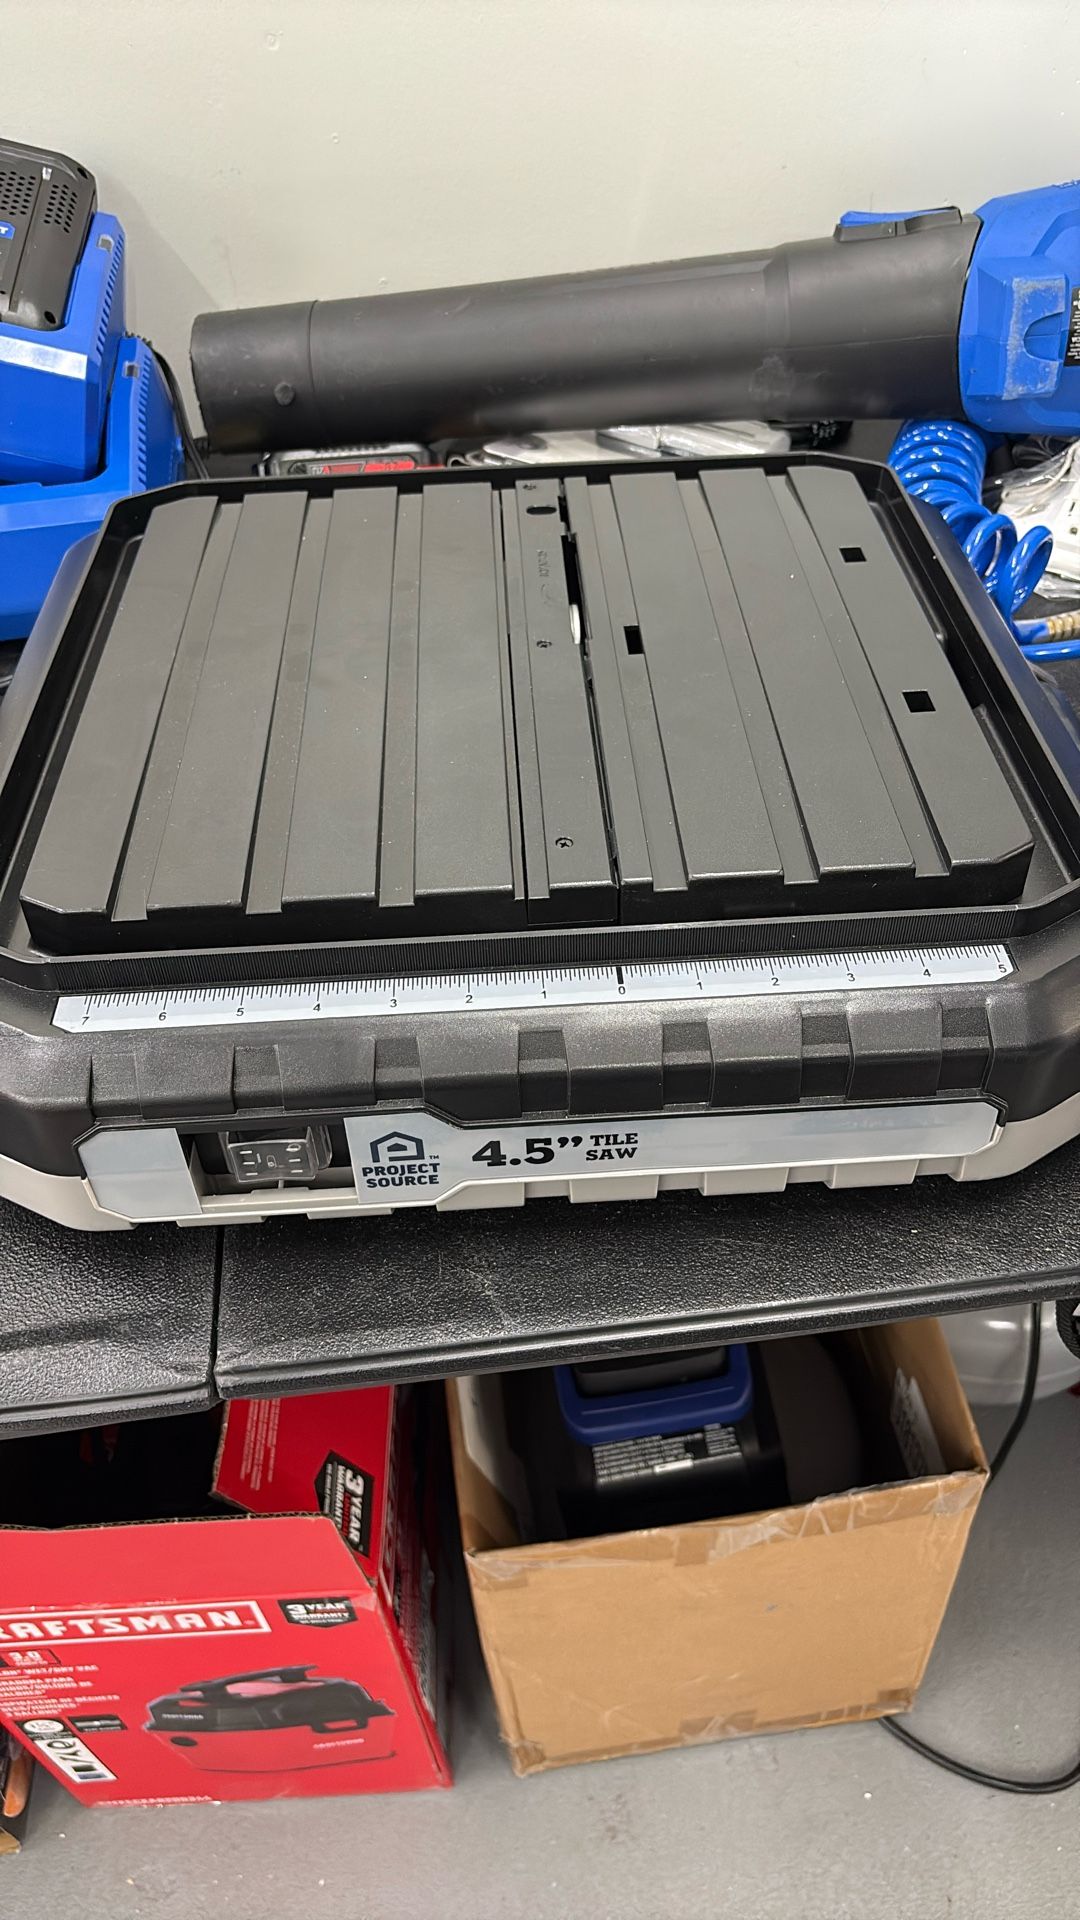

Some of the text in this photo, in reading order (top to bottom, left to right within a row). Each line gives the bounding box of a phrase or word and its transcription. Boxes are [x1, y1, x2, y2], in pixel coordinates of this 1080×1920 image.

[80, 964, 1007, 1026] 7 6 5 4 3 2 1 0 1 2 3 4 5
[589, 1132, 639, 1147] TILE
[585, 1147, 638, 1161] SAW
[361, 1162, 441, 1177] PROJECT
[366, 1174, 440, 1189] SOURCE
[345, 1468, 365, 1543] 3 YEAR
[285, 1603, 307, 1615] 3
